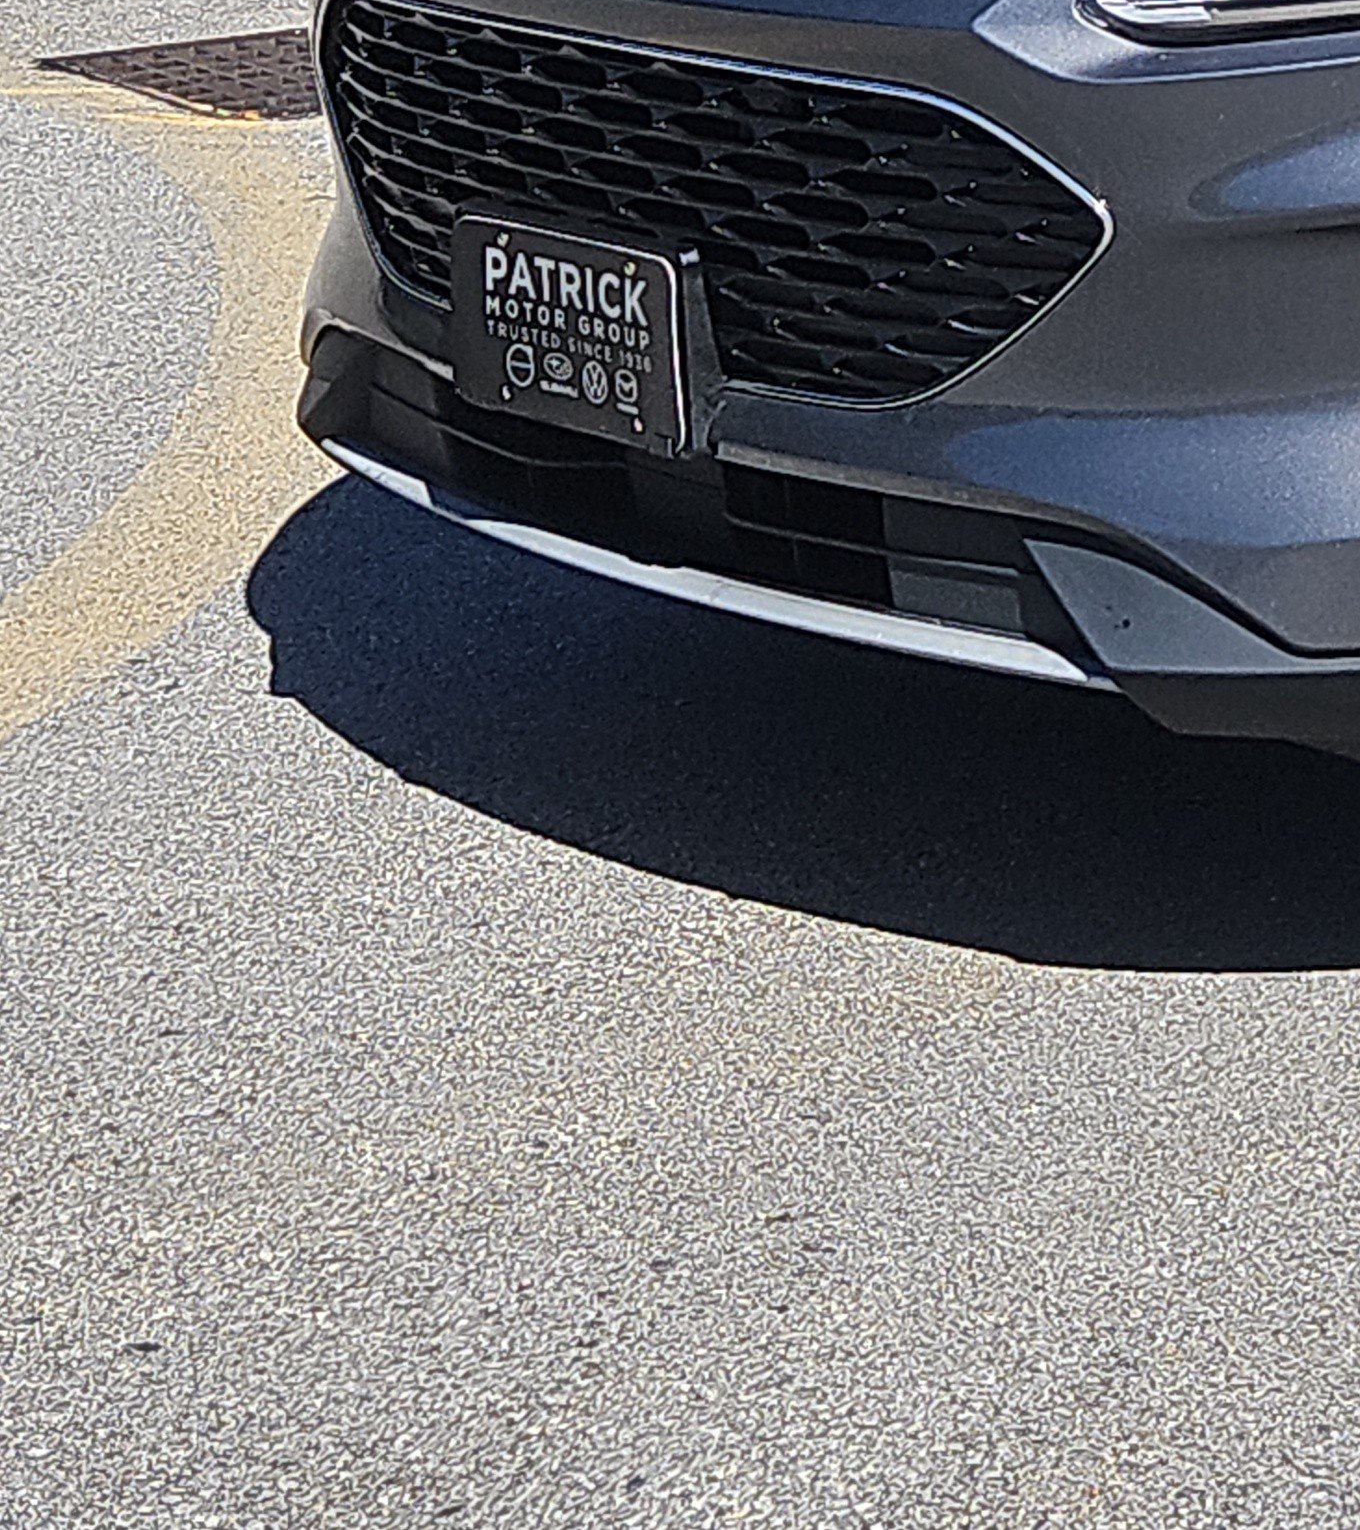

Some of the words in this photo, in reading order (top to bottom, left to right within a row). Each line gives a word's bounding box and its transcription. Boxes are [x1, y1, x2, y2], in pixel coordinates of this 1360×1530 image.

[485, 246, 648, 327] PATRICK
[485, 295, 566, 330] MOTOR
[578, 315, 650, 351] GROUP
[487, 320, 561, 349] TRUSTED
[567, 337, 613, 364] SINCE
